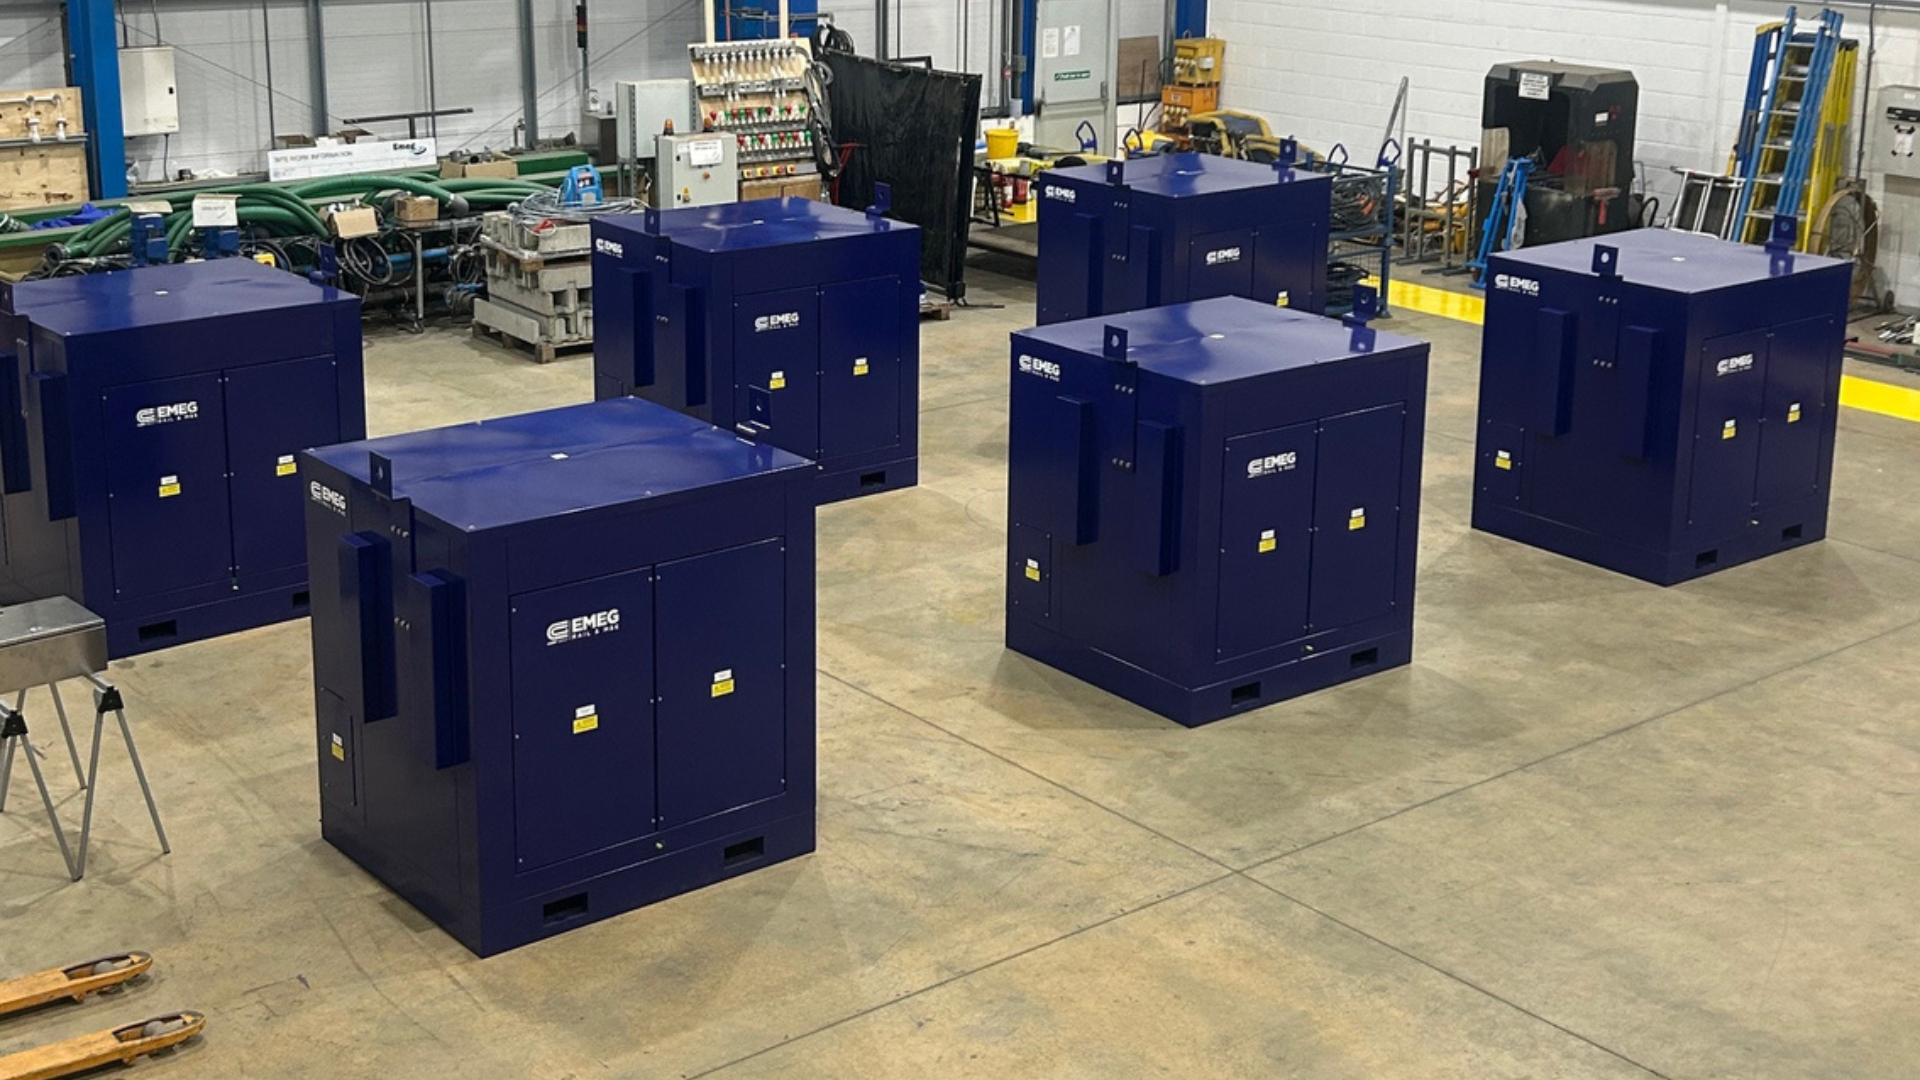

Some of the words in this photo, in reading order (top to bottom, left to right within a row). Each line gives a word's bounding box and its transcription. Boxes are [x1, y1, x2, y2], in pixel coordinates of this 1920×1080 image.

[1510, 276, 1539, 292] EMEG
[770, 312, 799, 325] EMEG
[1032, 357, 1060, 376] EMEG
[157, 401, 198, 418] EMEG
[1264, 451, 1296, 469] EMEG
[322, 486, 346, 510] EMEG
[572, 609, 619, 633] EMEG
